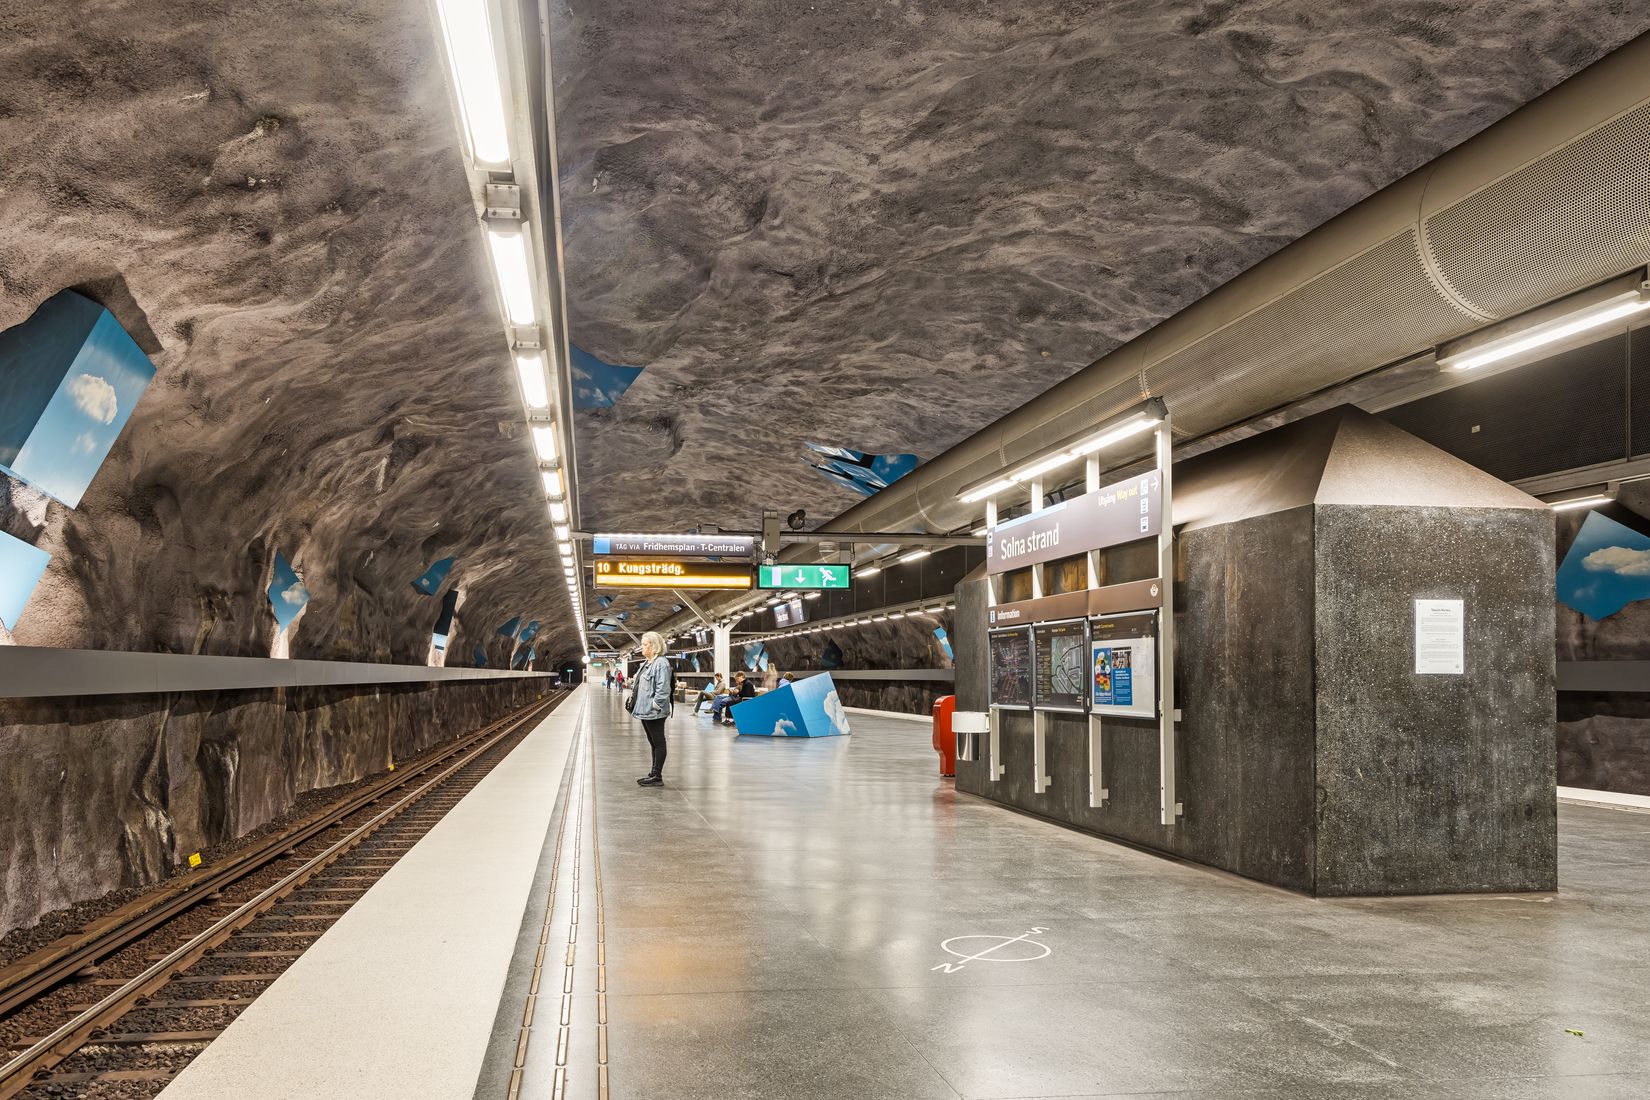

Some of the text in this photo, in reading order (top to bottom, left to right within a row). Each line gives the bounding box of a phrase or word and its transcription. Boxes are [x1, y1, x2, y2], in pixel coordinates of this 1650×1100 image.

[1117, 489, 1128, 501] Way
[1129, 485, 1138, 497] out
[1000, 522, 1060, 560] Solna strand
[643, 542, 696, 553] Fridhemsplan
[700, 543, 745, 552] T-Centralen
[597, 562, 685, 575] 10 Kungsträdg.
[997, 609, 1021, 620] Information
[1025, 926, 1050, 935] S
[930, 962, 966, 974] N
